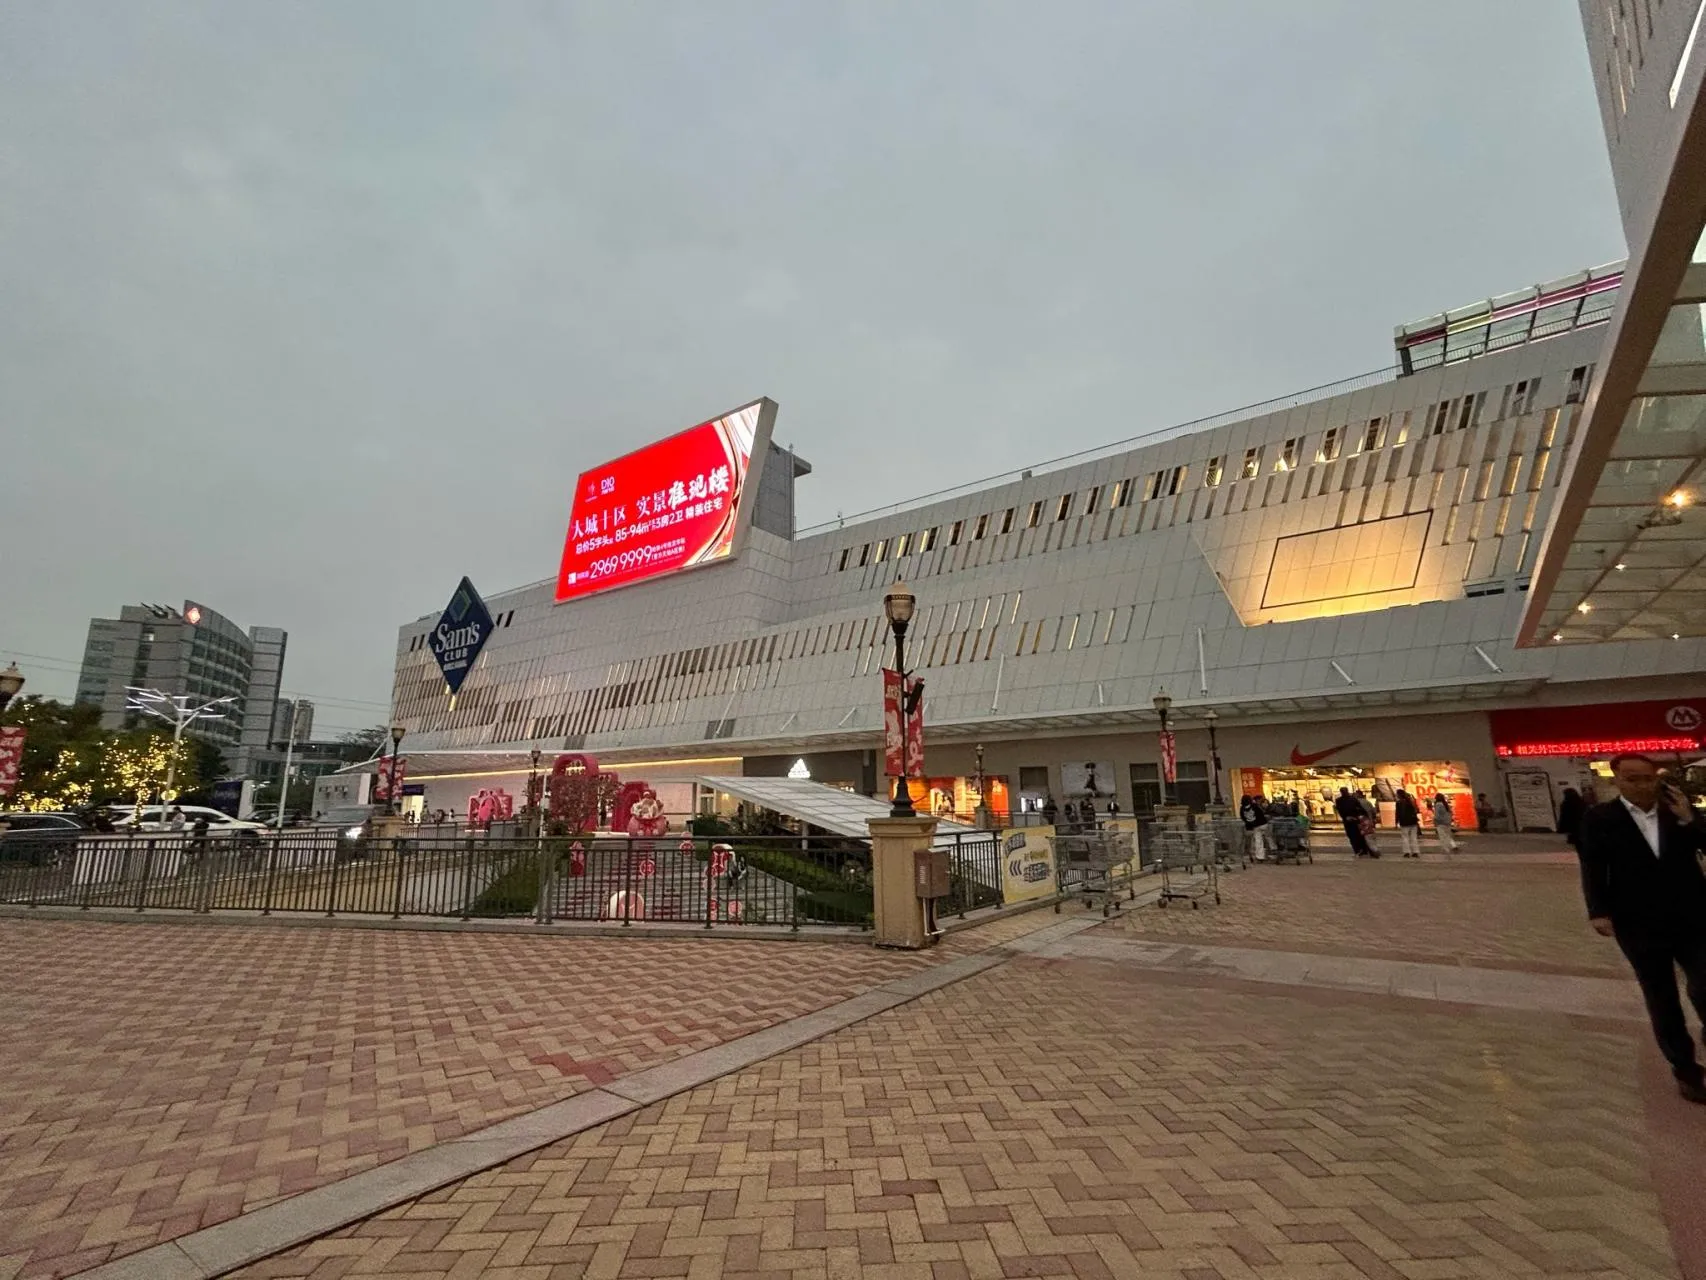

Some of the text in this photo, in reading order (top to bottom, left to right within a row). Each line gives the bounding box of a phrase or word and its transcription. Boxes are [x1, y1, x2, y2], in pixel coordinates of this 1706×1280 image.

[590, 546, 653, 579] 2969 9999
[435, 621, 480, 653] Sam's
[444, 647, 468, 661] CLUB
[1404, 772, 1436, 785] JUST
[1416, 785, 1438, 798] DO
